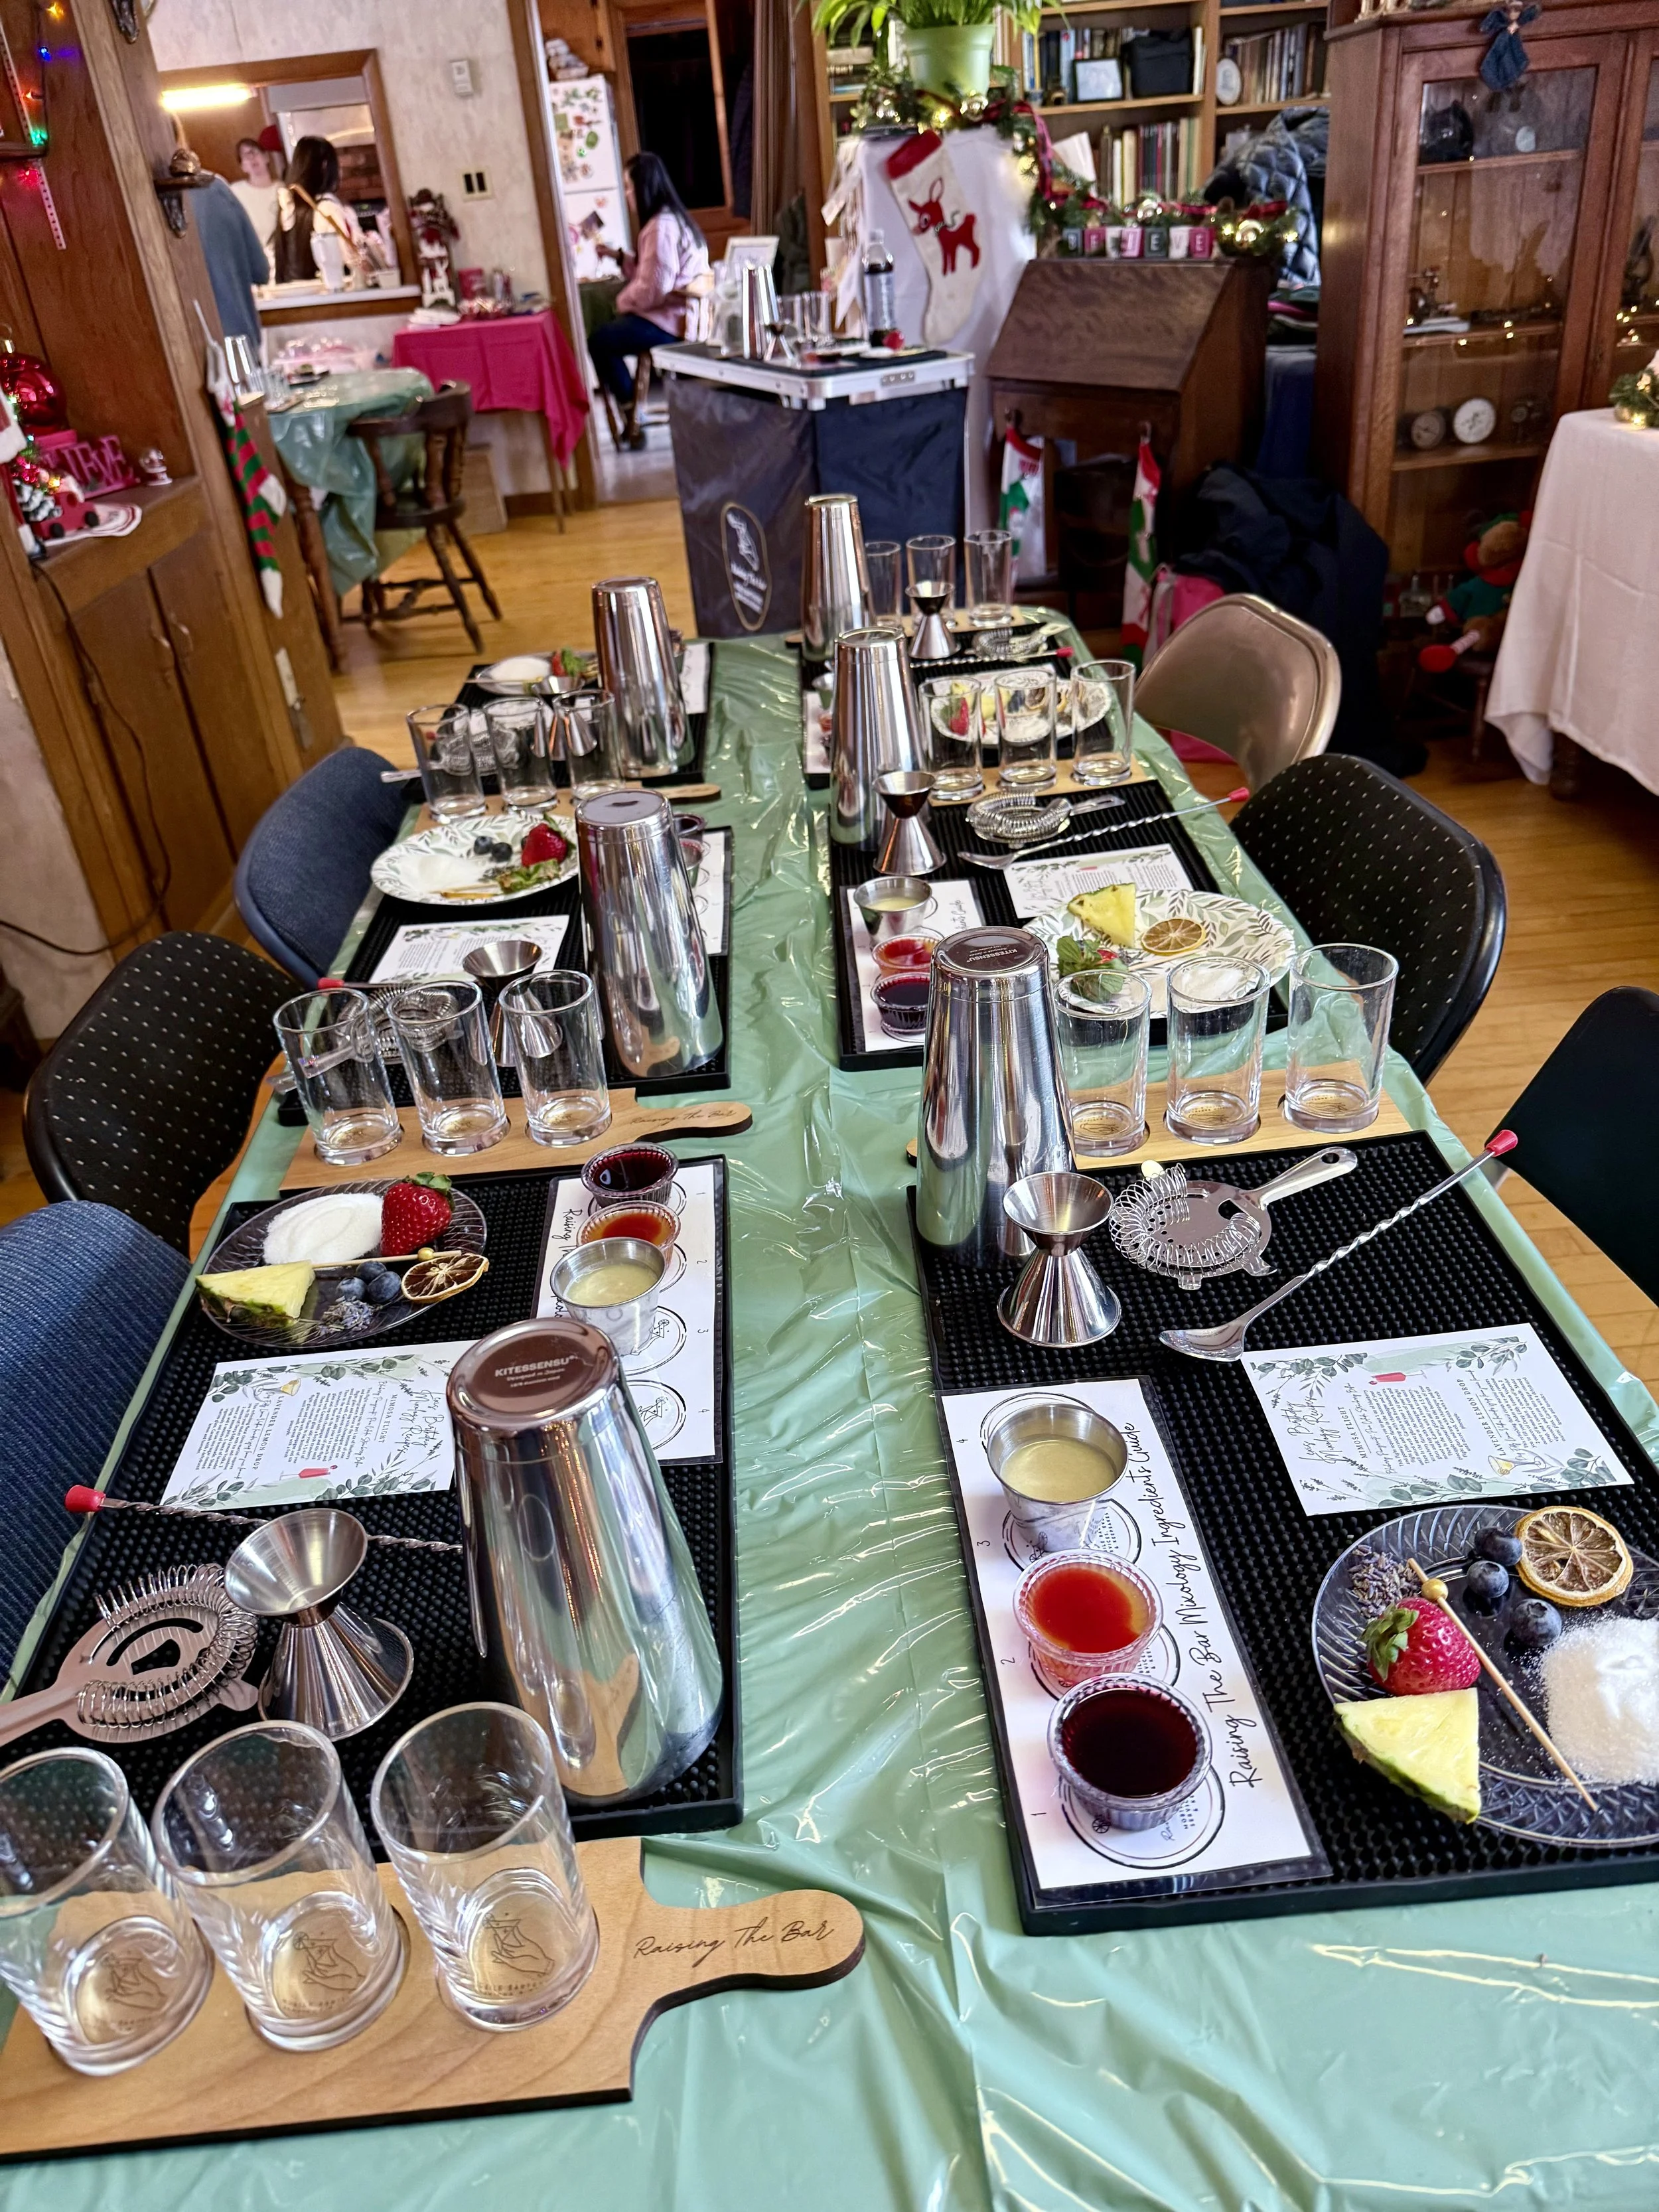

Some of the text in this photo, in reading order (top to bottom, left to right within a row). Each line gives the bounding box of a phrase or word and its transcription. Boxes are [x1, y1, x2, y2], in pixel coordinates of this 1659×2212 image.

[552, 1209, 583, 1241] Raising
[252, 1396, 283, 1469] LAVENDER LEMON DROP
[378, 1394, 397, 1442] MIMOSA FLIGHT
[1337, 1406, 1367, 1458] MIMOSA FLIGHT
[1457, 1379, 1505, 1455] LAVENDER LEMON DROP
[1126, 1422, 1263, 1789] Raising The Bar Mixology Ingredients Guide
[633, 1917, 834, 1968] Raising The Bar
